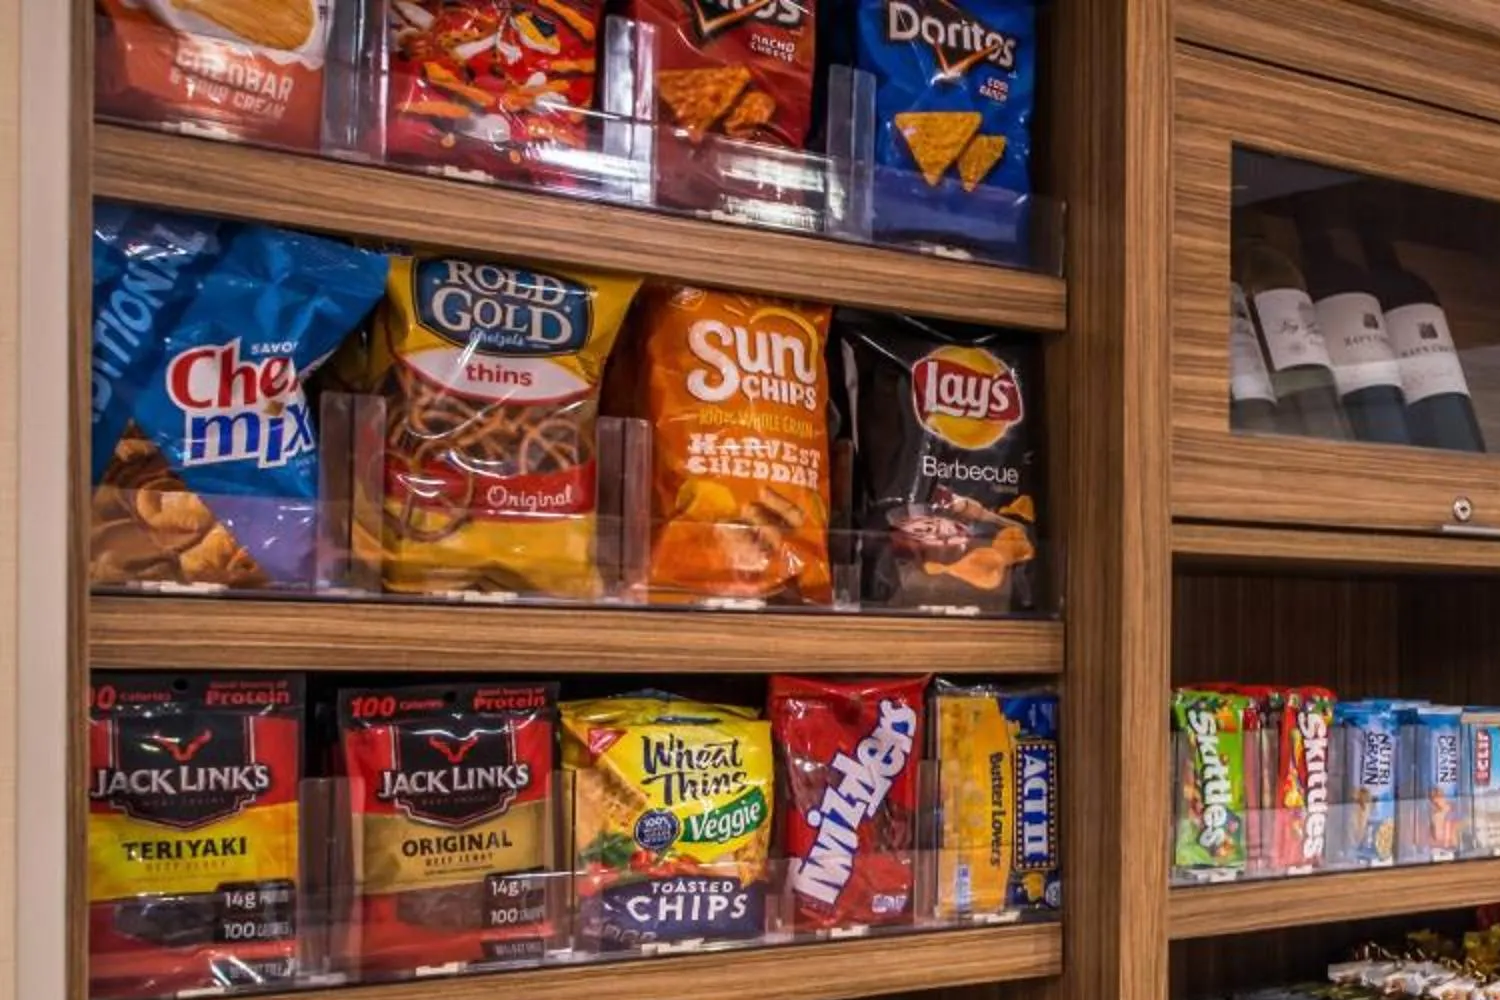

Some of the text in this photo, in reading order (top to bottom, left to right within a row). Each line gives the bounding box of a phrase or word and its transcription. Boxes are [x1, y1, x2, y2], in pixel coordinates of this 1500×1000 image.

[888, 0, 1017, 67] Doritos
[443, 259, 567, 306] ROLD
[432, 286, 573, 345] GOLD
[251, 342, 297, 354] SAVO
[687, 319, 817, 401] Sun
[169, 347, 298, 409] Che
[465, 364, 533, 387] thins
[741, 374, 817, 411] CHIPS
[190, 403, 314, 464] mix
[687, 433, 821, 468] HARVEST
[687, 456, 819, 489] CHEDDAR
[923, 455, 1019, 485] Barbecue
[487, 483, 573, 509] Original
[205, 689, 291, 705] Protein
[351, 695, 396, 718] 100
[472, 694, 546, 712] Protein
[641, 732, 744, 775] Wheat
[91, 765, 175, 797] JACK
[378, 769, 450, 799] JACK
[640, 770, 748, 807] Thins
[1022, 754, 1049, 815] ACT
[1187, 709, 1233, 849] Skittles
[1298, 712, 1329, 859] Skittles
[689, 800, 762, 844] Veggie
[990, 752, 1007, 867] Butter Lovers
[122, 837, 248, 861] TERIYAKI
[401, 830, 513, 858] ORIGINAL
[651, 879, 735, 895] TOASTED
[626, 894, 749, 923] CHIPS
